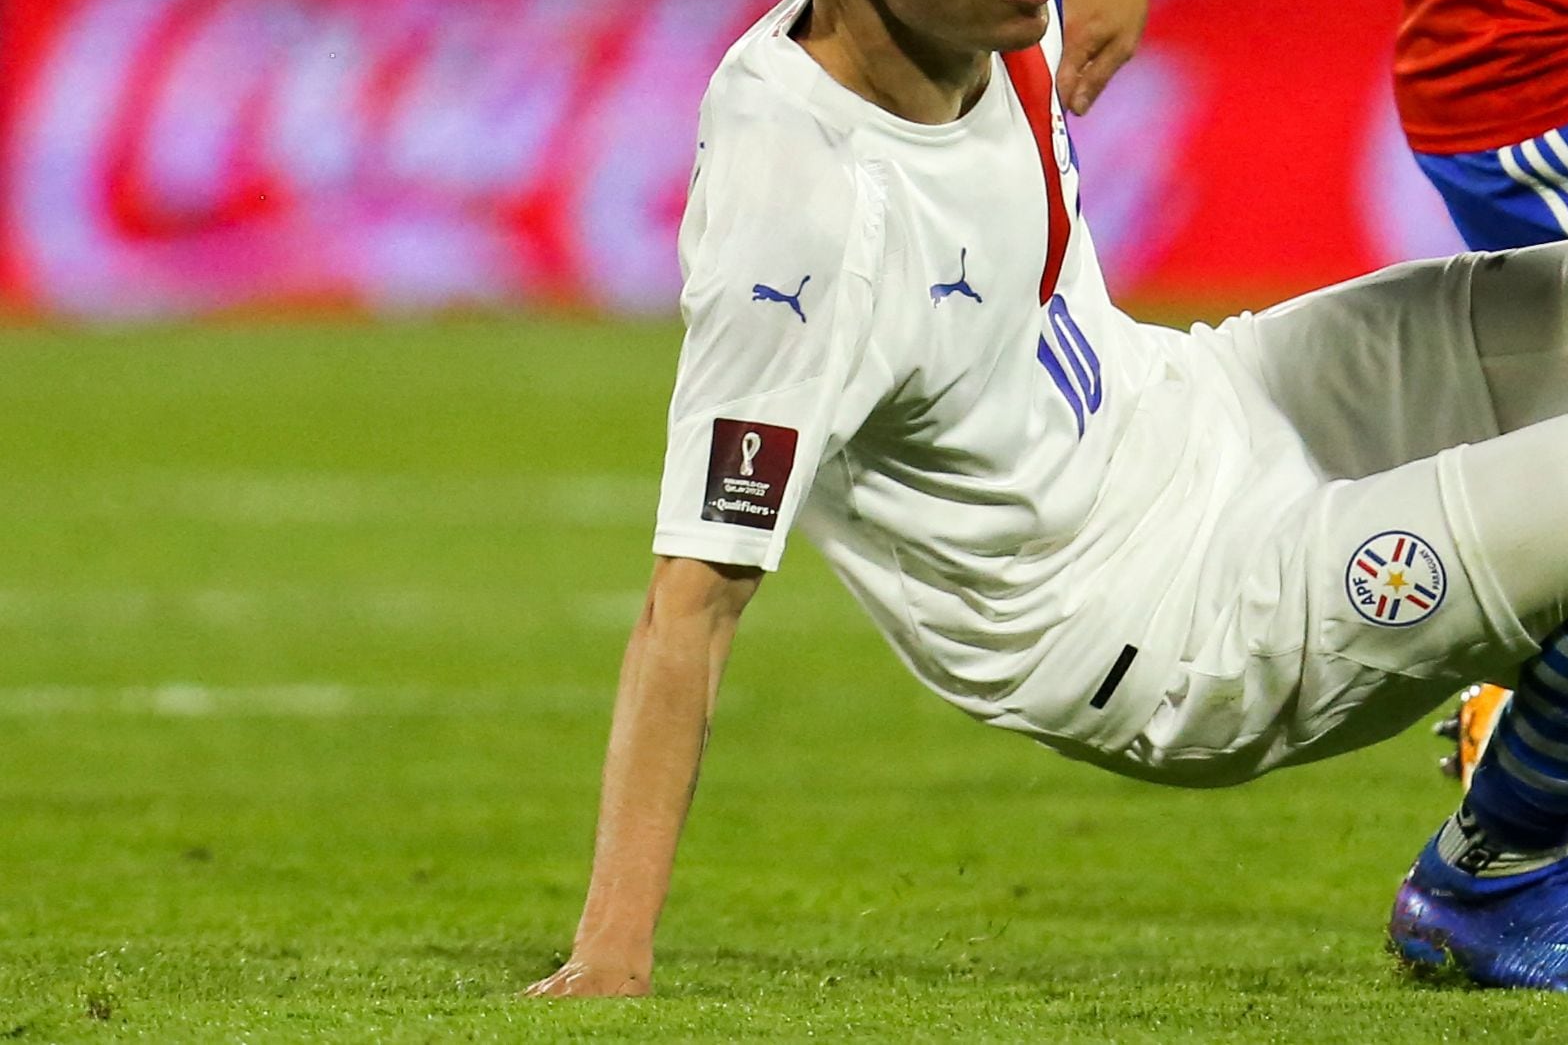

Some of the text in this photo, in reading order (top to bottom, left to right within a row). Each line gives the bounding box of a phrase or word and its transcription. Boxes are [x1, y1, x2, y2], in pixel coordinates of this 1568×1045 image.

[1037, 293, 1102, 443] 10
[716, 497, 770, 516] Qualifiers
[1418, 548, 1441, 591] PARAGUAY
[1352, 576, 1377, 606] APF
